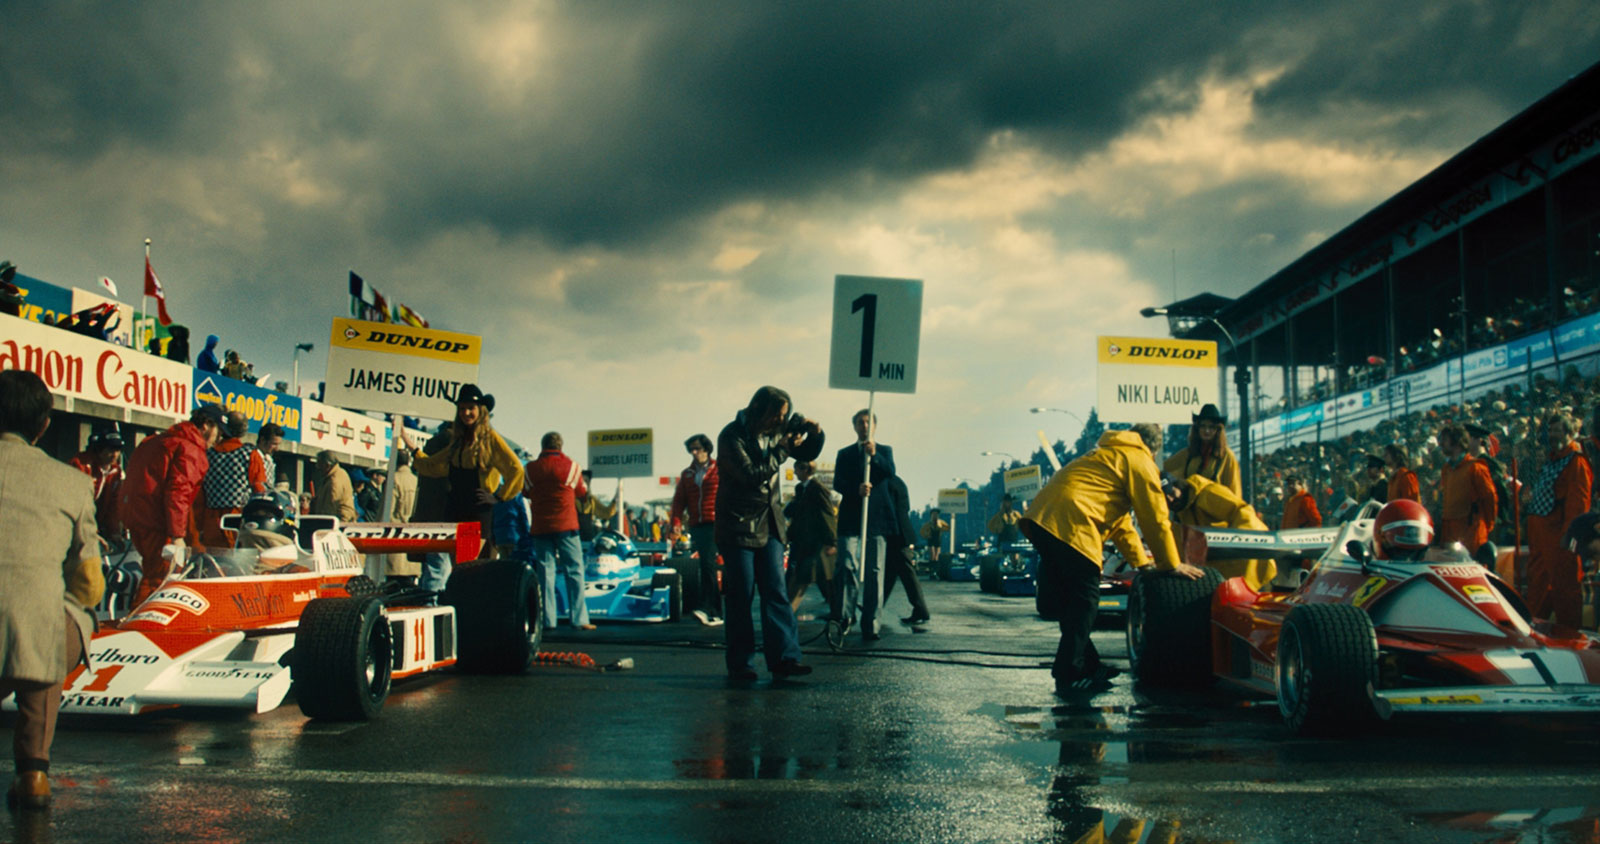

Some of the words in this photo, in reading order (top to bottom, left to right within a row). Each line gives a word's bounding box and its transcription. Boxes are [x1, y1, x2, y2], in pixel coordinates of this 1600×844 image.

[366, 331, 470, 353] DUNLOP
[851, 293, 878, 379] 1
[1127, 346, 1209, 360] DUNLOP
[0, 339, 83, 393] anon
[879, 362, 905, 381] MIN
[96, 349, 187, 415] Canon
[344, 368, 407, 394] JAMES
[412, 376, 461, 402] HUNT
[1117, 384, 1148, 404] NIKI
[1154, 386, 1200, 405] LAUDA
[225, 391, 300, 430] GOODYEAR
[150, 592, 202, 609] XACO
[231, 583, 286, 617] Marlboro
[414, 617, 426, 662] 11
[88, 648, 159, 664] rlboro
[185, 668, 274, 680] GOODYEAR
[60, 693, 124, 709] YEAR
